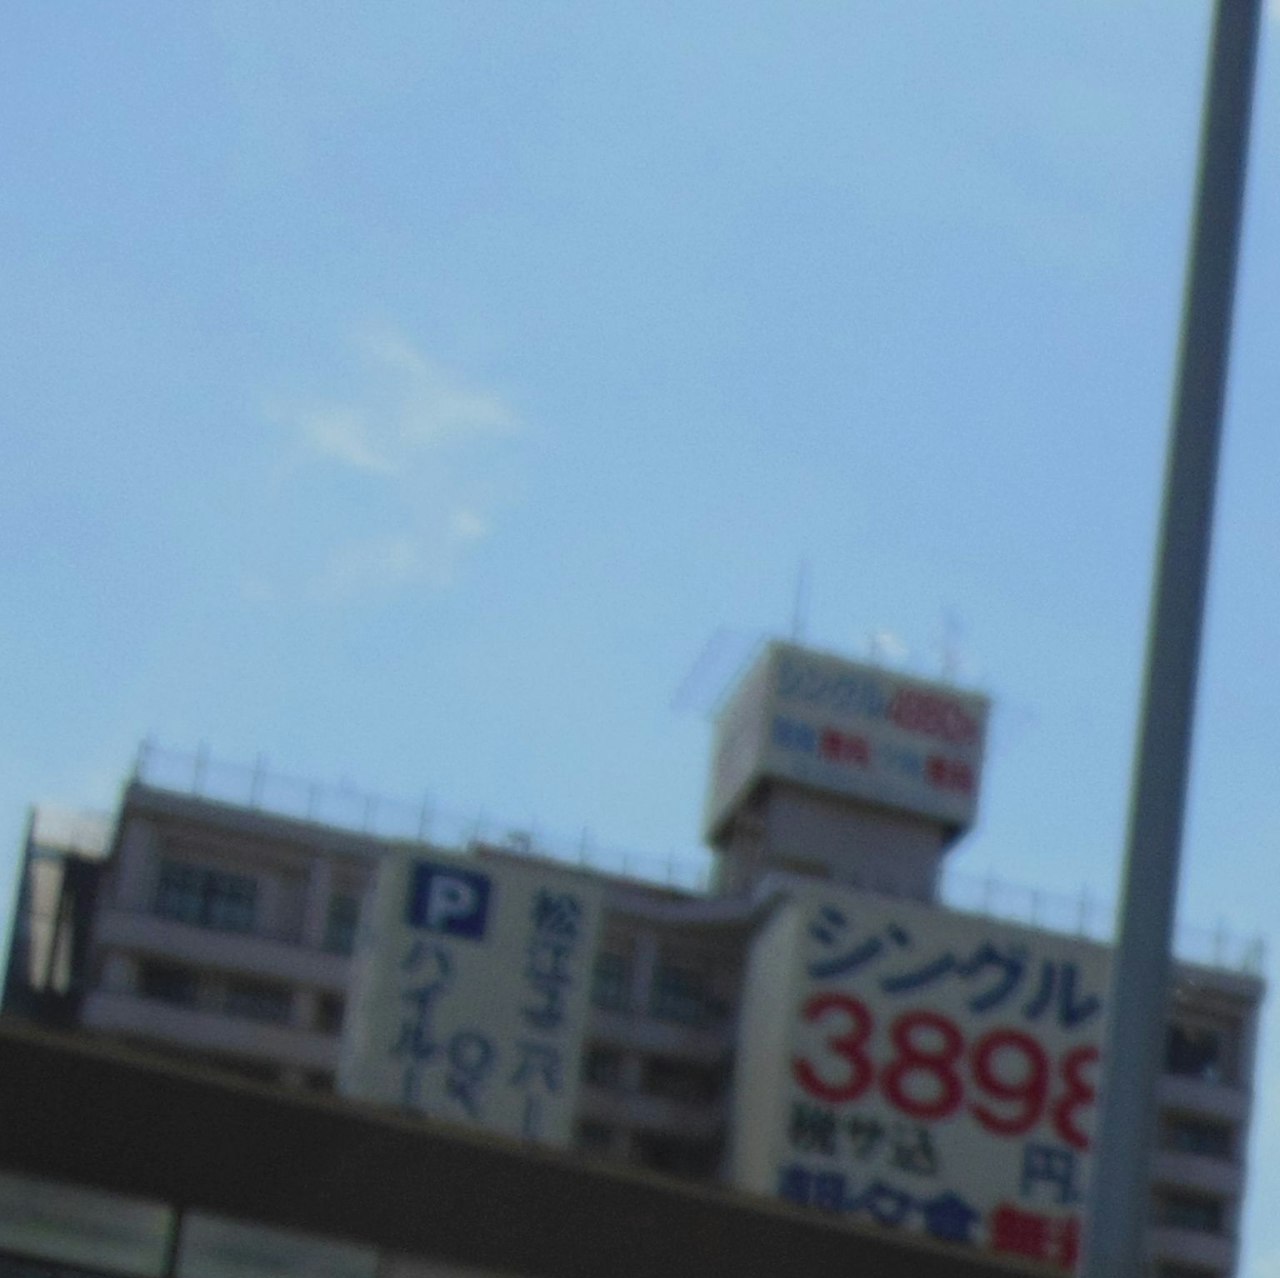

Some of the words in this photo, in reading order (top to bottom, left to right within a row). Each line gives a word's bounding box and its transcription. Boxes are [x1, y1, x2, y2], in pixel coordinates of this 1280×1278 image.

[427, 874, 480, 931] P
[807, 907, 1100, 1028] シングル
